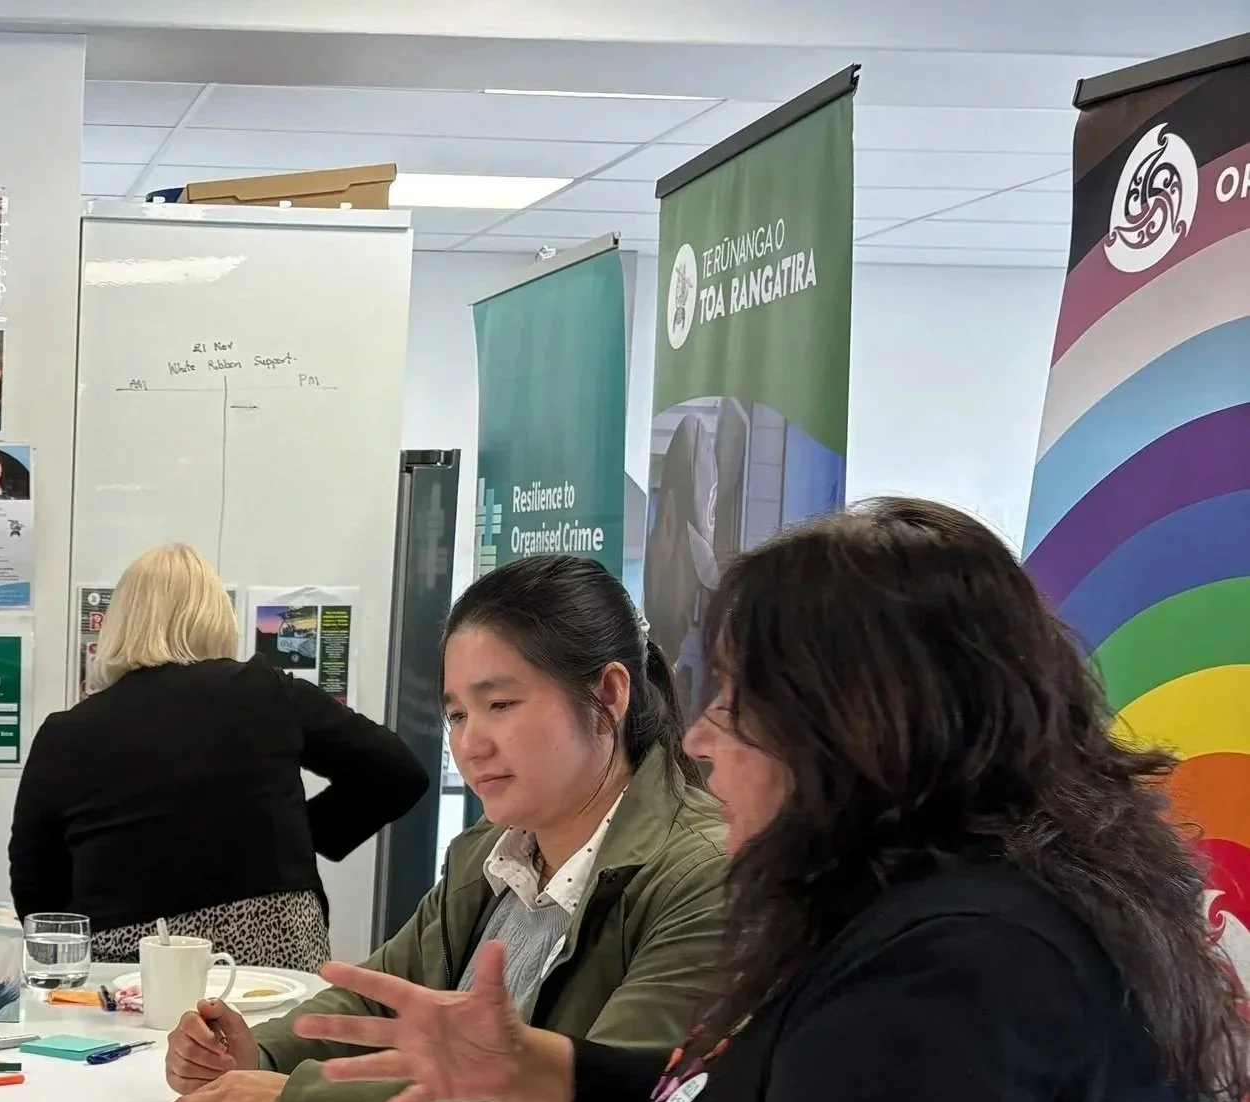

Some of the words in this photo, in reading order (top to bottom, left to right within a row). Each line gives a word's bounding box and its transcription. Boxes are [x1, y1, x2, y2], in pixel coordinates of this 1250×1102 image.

[703, 249, 713, 279] TE
[713, 223, 773, 274] RŪNANGA
[775, 218, 785, 250] O
[700, 282, 725, 324] TOA
[730, 248, 817, 314] RANGATIRA
[513, 480, 563, 513] Resilience
[564, 480, 575, 508] to
[511, 521, 561, 558] Organised
[562, 520, 604, 552] Crime
